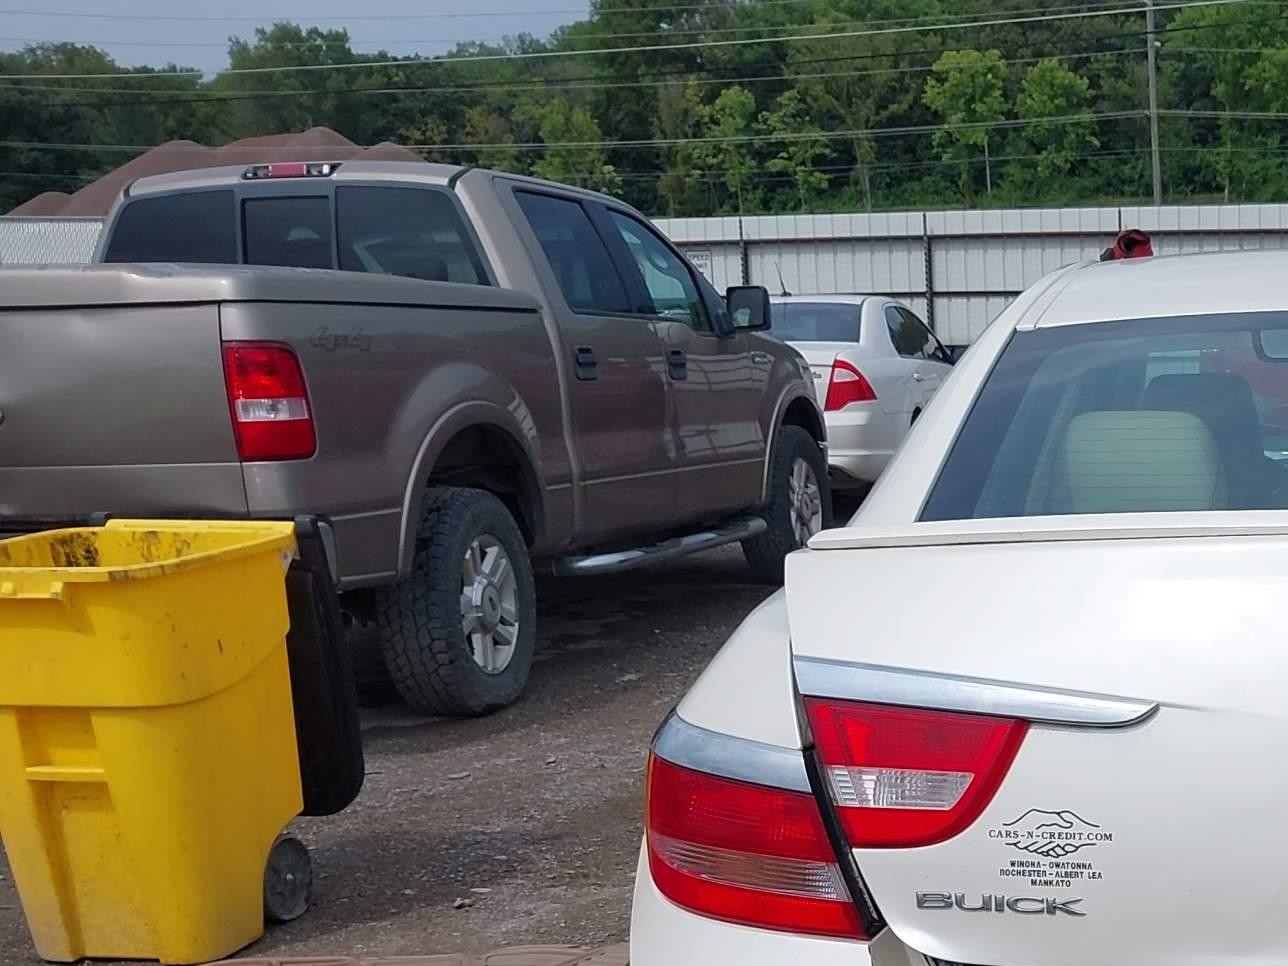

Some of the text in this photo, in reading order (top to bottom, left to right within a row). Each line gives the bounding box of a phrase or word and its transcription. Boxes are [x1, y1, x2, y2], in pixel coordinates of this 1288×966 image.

[988, 829, 1113, 842] CARS-N-CREDIT.COM
[1087, 871, 1103, 880] LEA
[1030, 878, 1072, 888] MANKATO
[915, 890, 1087, 916] BUICK
